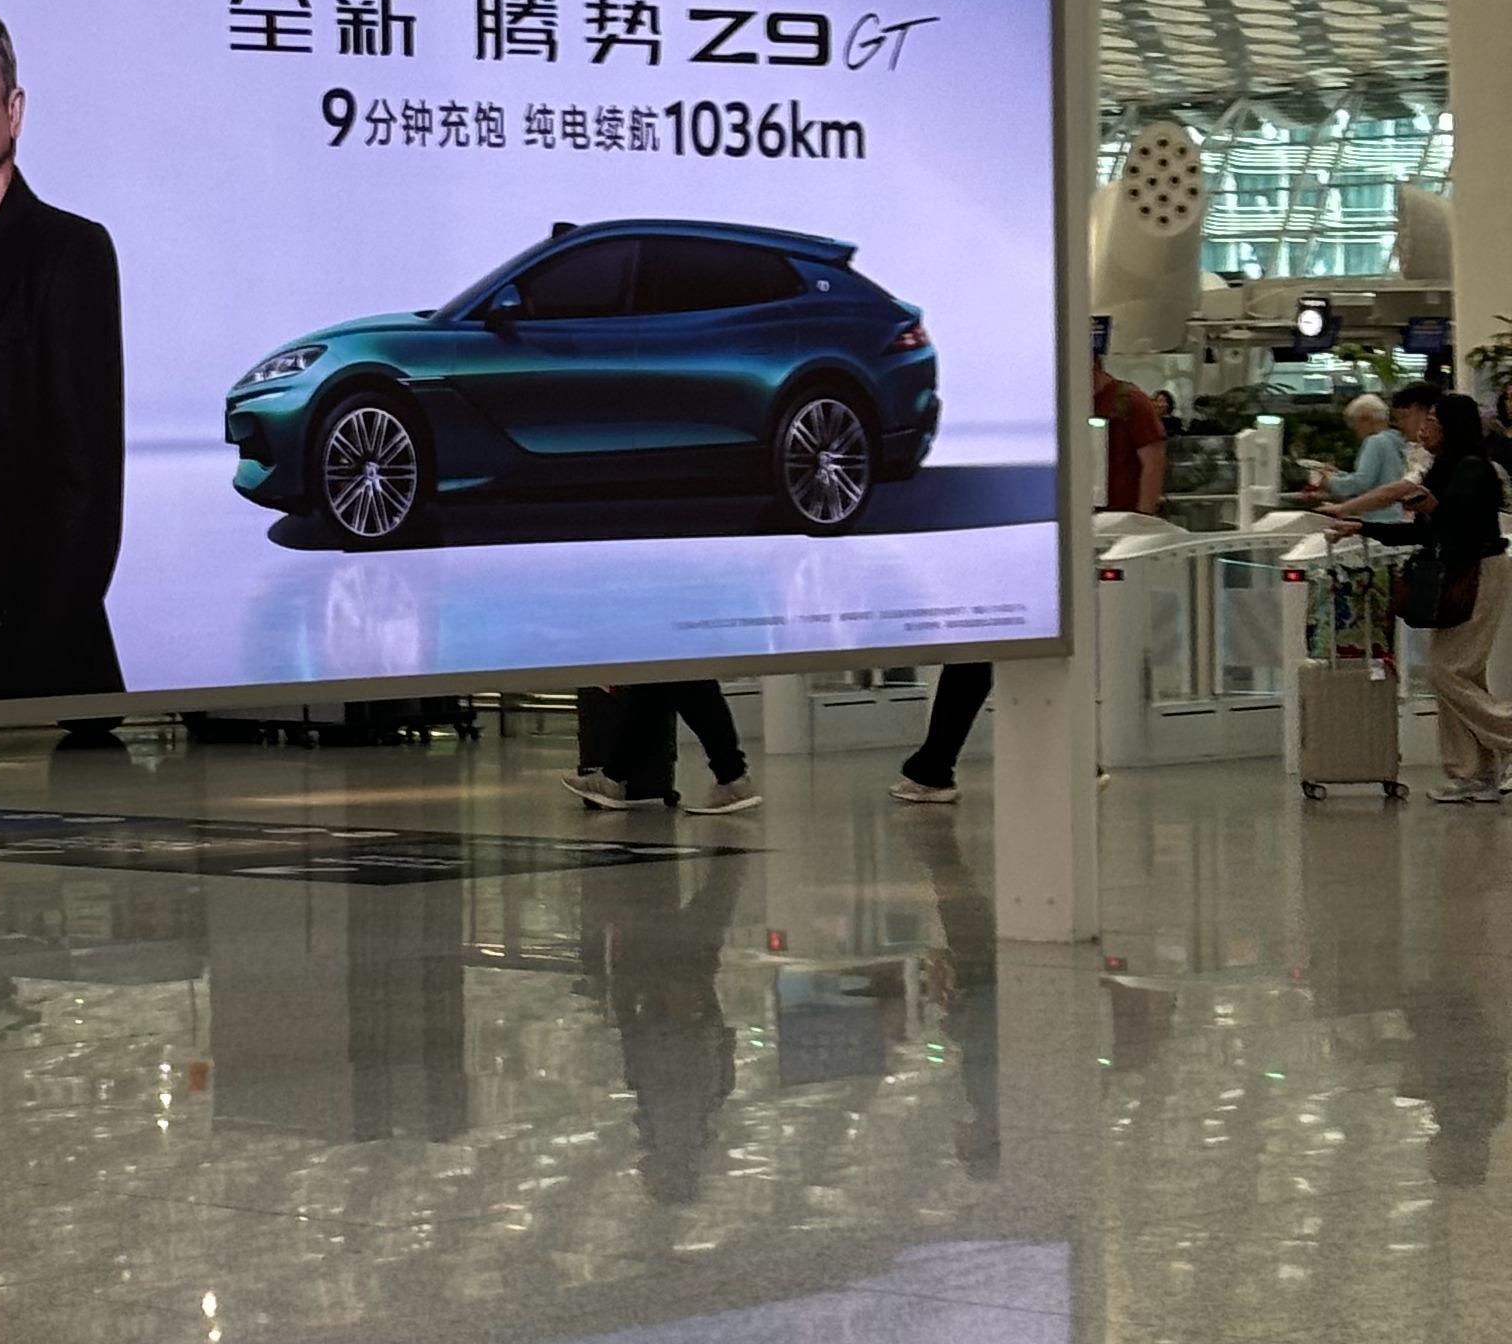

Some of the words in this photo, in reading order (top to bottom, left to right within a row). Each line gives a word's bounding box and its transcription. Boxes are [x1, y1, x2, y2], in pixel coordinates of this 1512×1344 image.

[321, 86, 507, 150] 9分钟充饱
[523, 98, 866, 160] 纯电续航1036km
